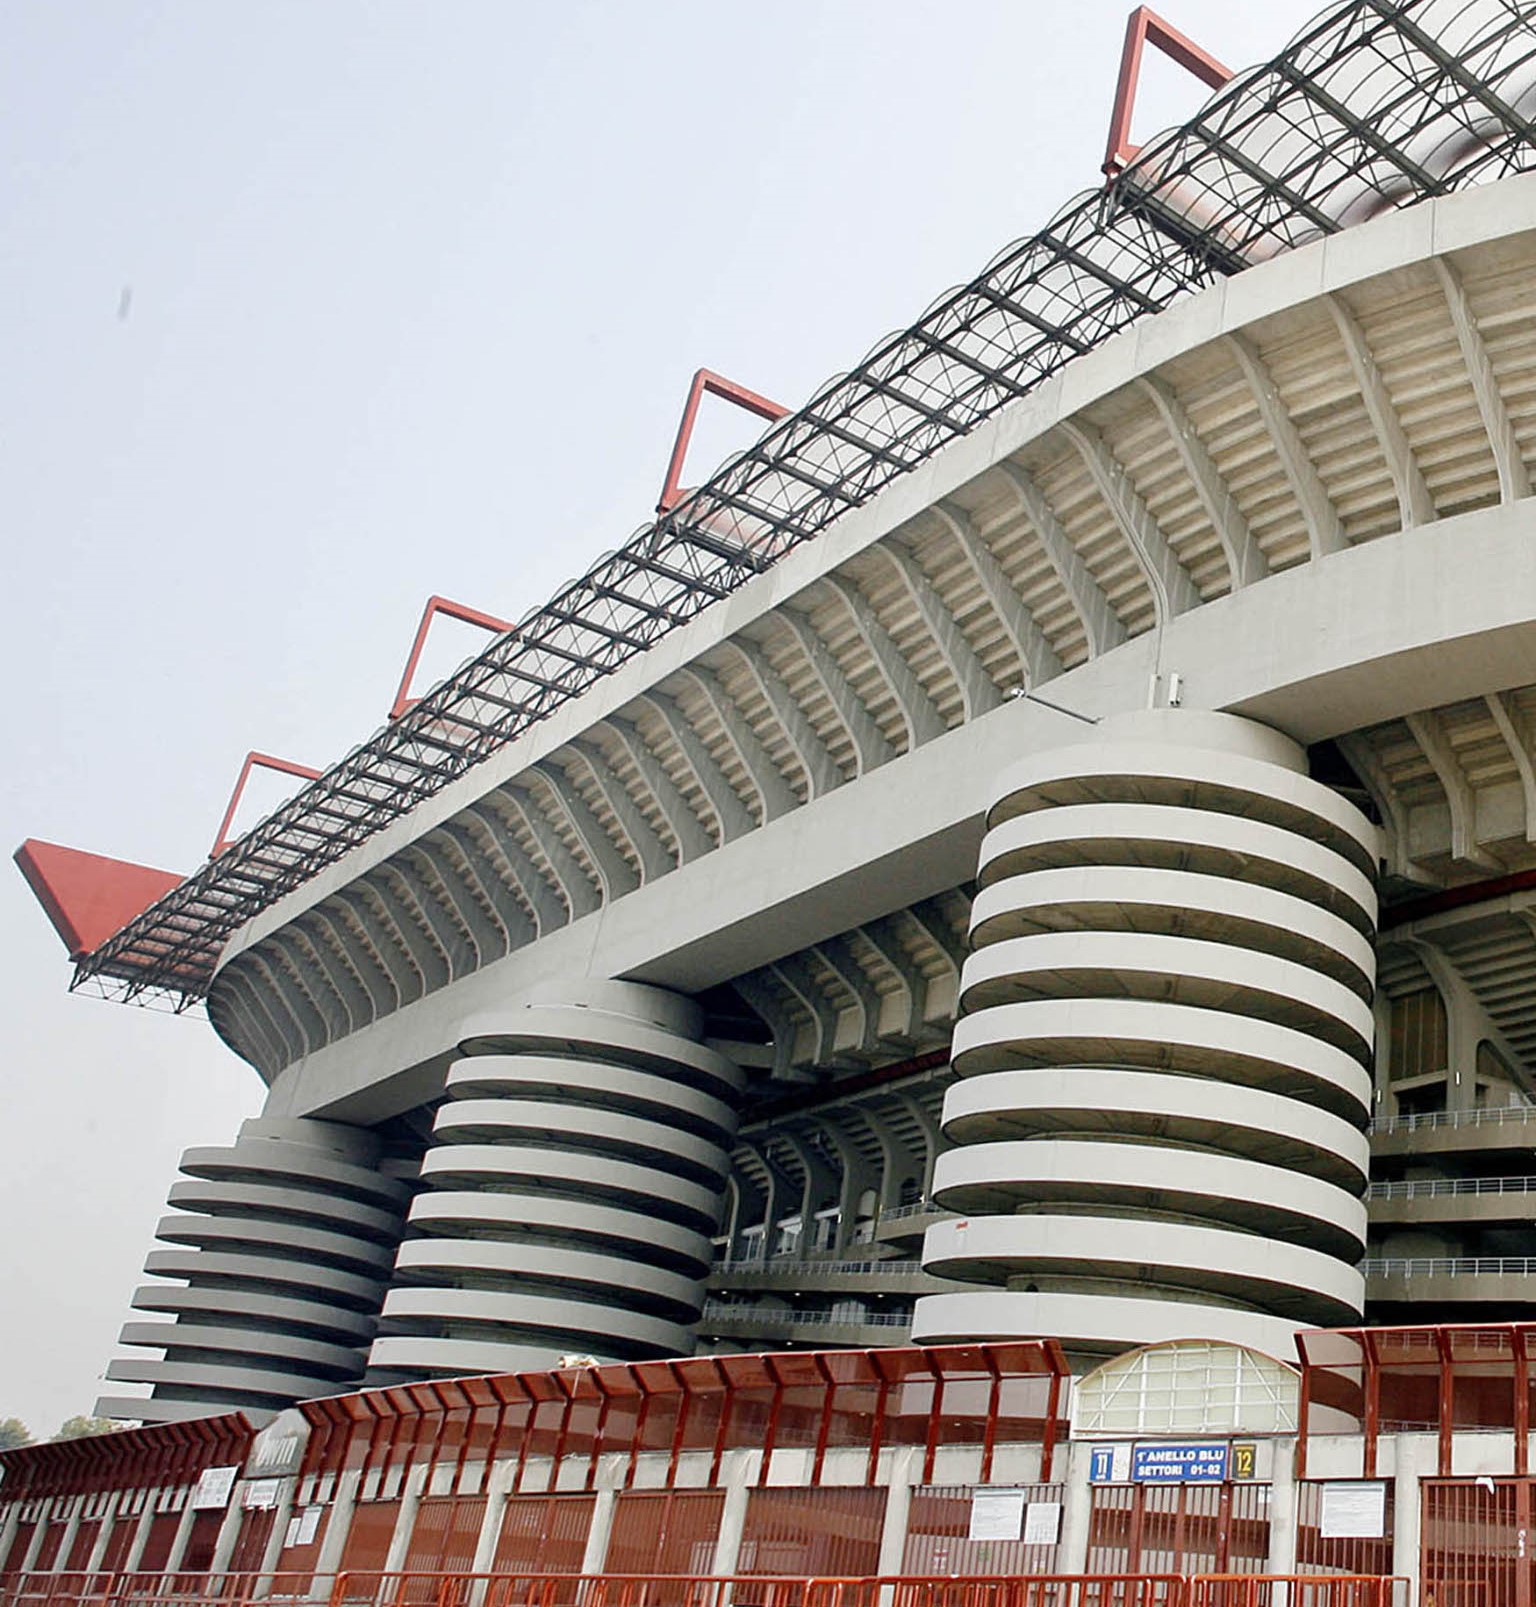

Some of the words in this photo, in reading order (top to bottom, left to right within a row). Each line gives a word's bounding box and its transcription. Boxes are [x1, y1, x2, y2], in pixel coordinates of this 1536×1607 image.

[1147, 1451, 1196, 1462] ANELLO
[1199, 1449, 1225, 1460] BLU
[1236, 1451, 1252, 1472] 12
[1097, 1454, 1108, 1474] 11
[1138, 1465, 1183, 1476] SETTORI
[1190, 1464, 1221, 1475] 01-02
